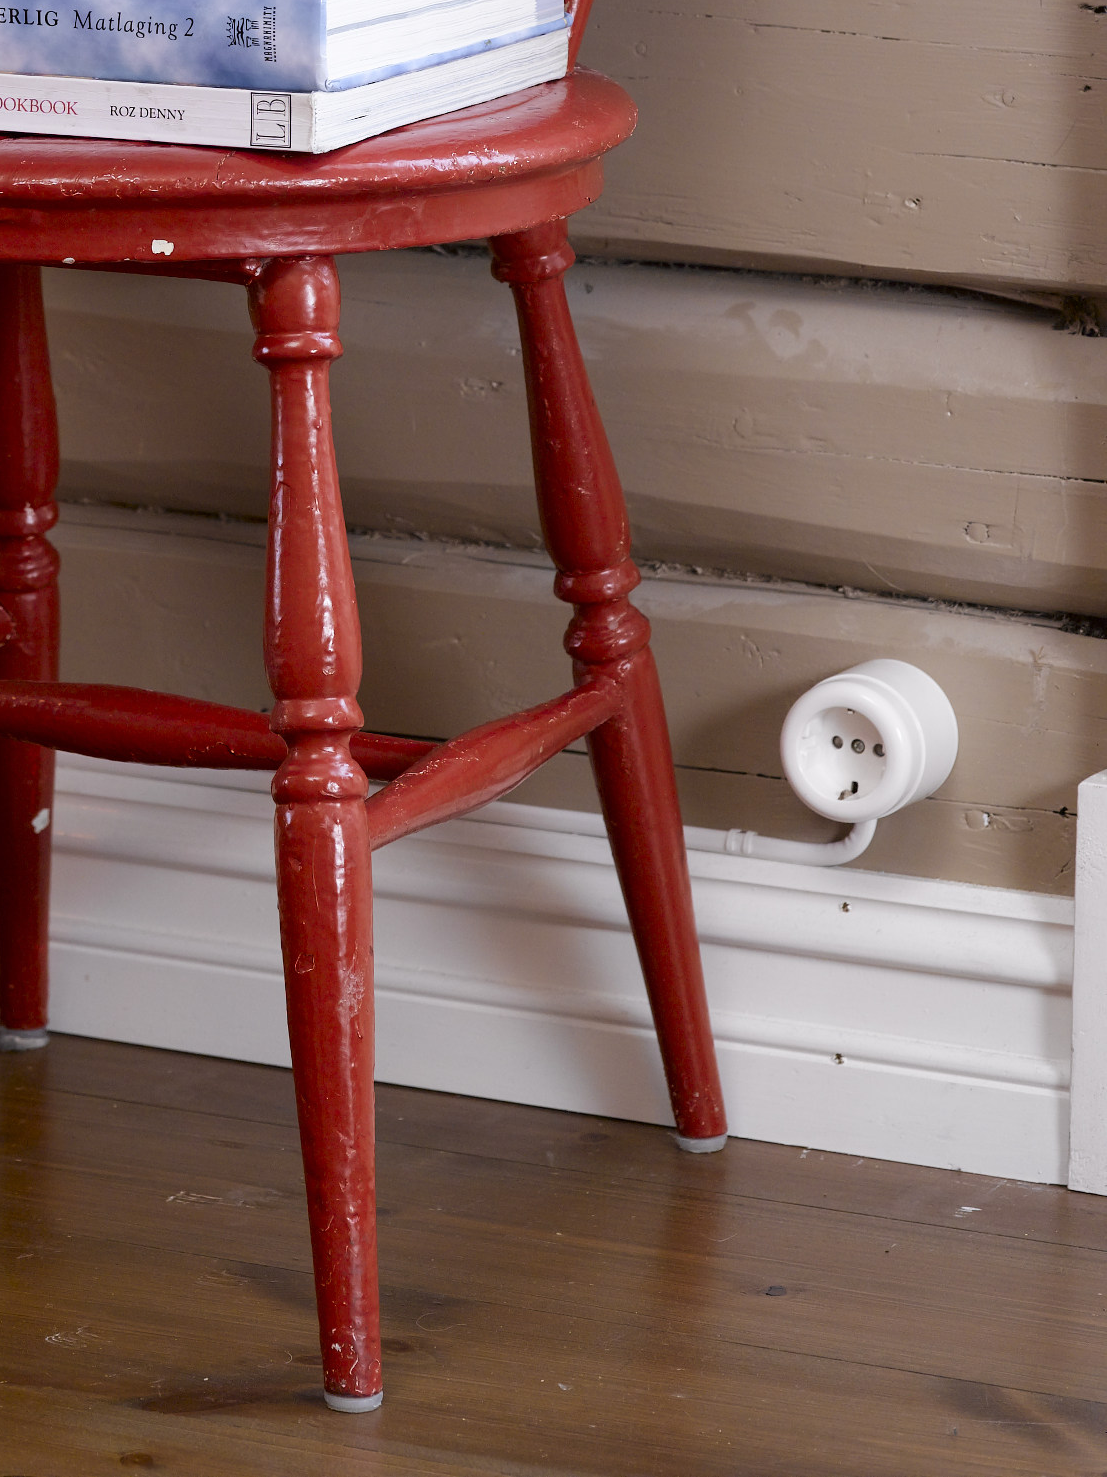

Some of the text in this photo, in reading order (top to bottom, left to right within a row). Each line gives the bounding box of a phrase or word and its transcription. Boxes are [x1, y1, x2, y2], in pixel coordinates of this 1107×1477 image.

[73, 8, 179, 41] Matlaging
[183, 17, 195, 37] 2
[109, 104, 186, 122] ROZ DENNY
